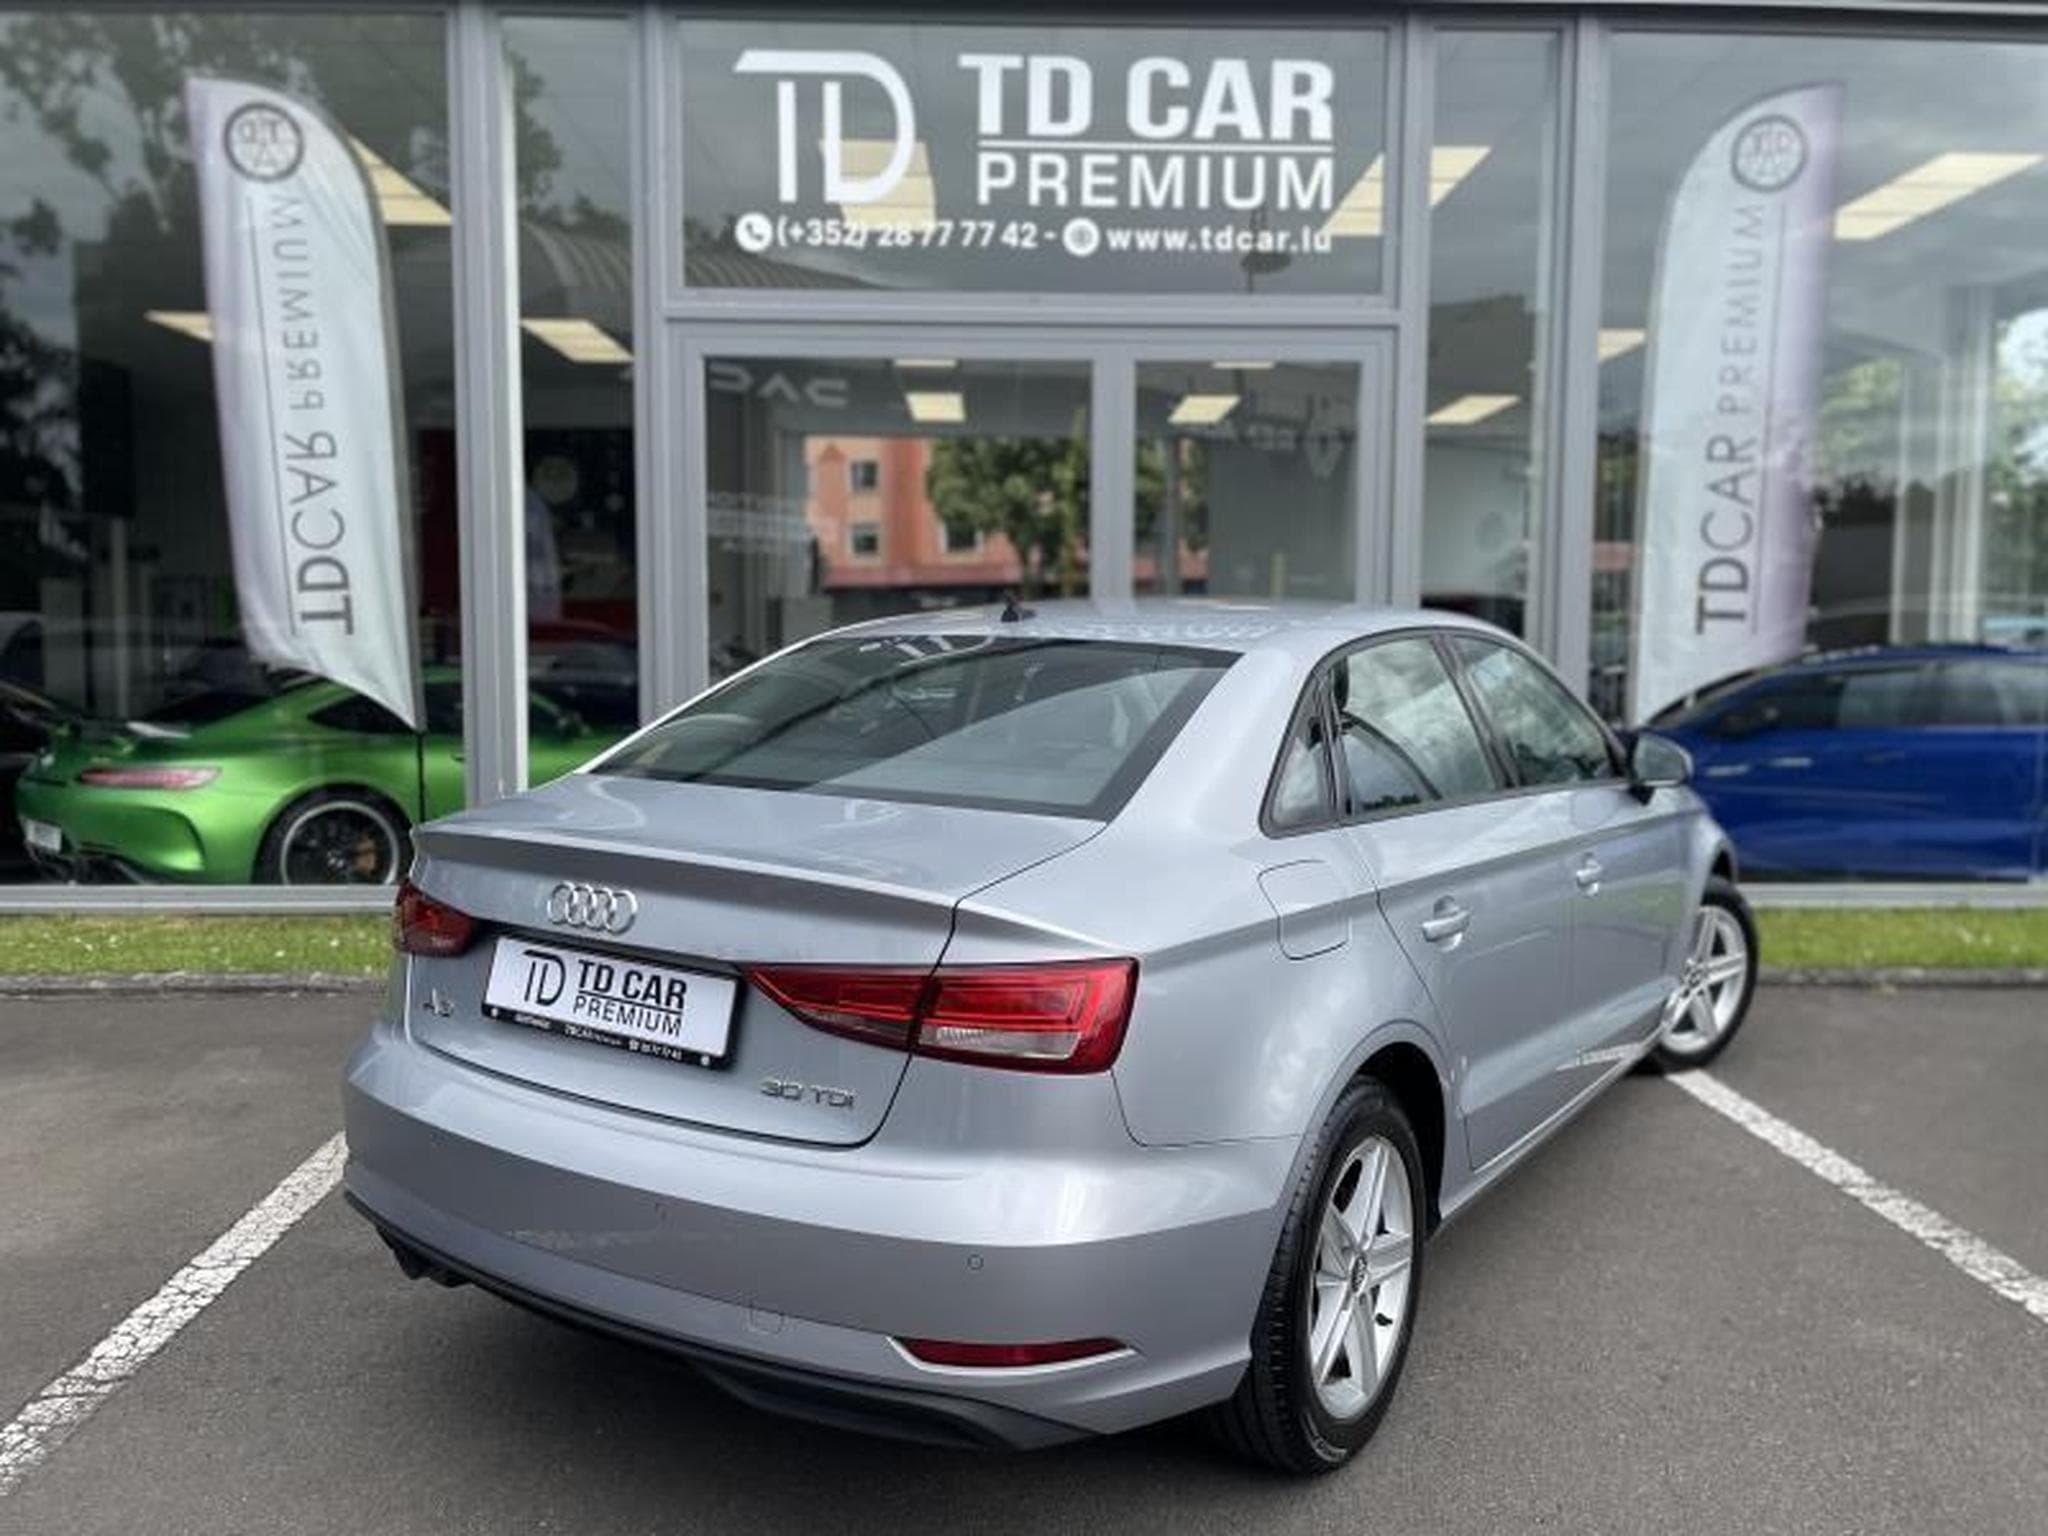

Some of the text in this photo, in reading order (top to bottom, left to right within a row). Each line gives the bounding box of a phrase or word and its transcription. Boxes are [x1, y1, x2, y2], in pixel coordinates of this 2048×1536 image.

[958, 54, 1334, 141] TD CAR
[978, 153, 1334, 210] PREMIUM
[876, 219, 914, 247] 28
[921, 220, 953, 247] 77
[960, 220, 995, 248] 77
[1001, 221, 1038, 249] 42
[1106, 225, 1332, 252] www.tdcar.lu
[1695, 203, 1765, 635] TDCAR PREMIUM
[578, 959, 687, 1009] TD CAR
[573, 995, 682, 1037] PREMIUM
[761, 1079, 854, 1108] 30 TDI
